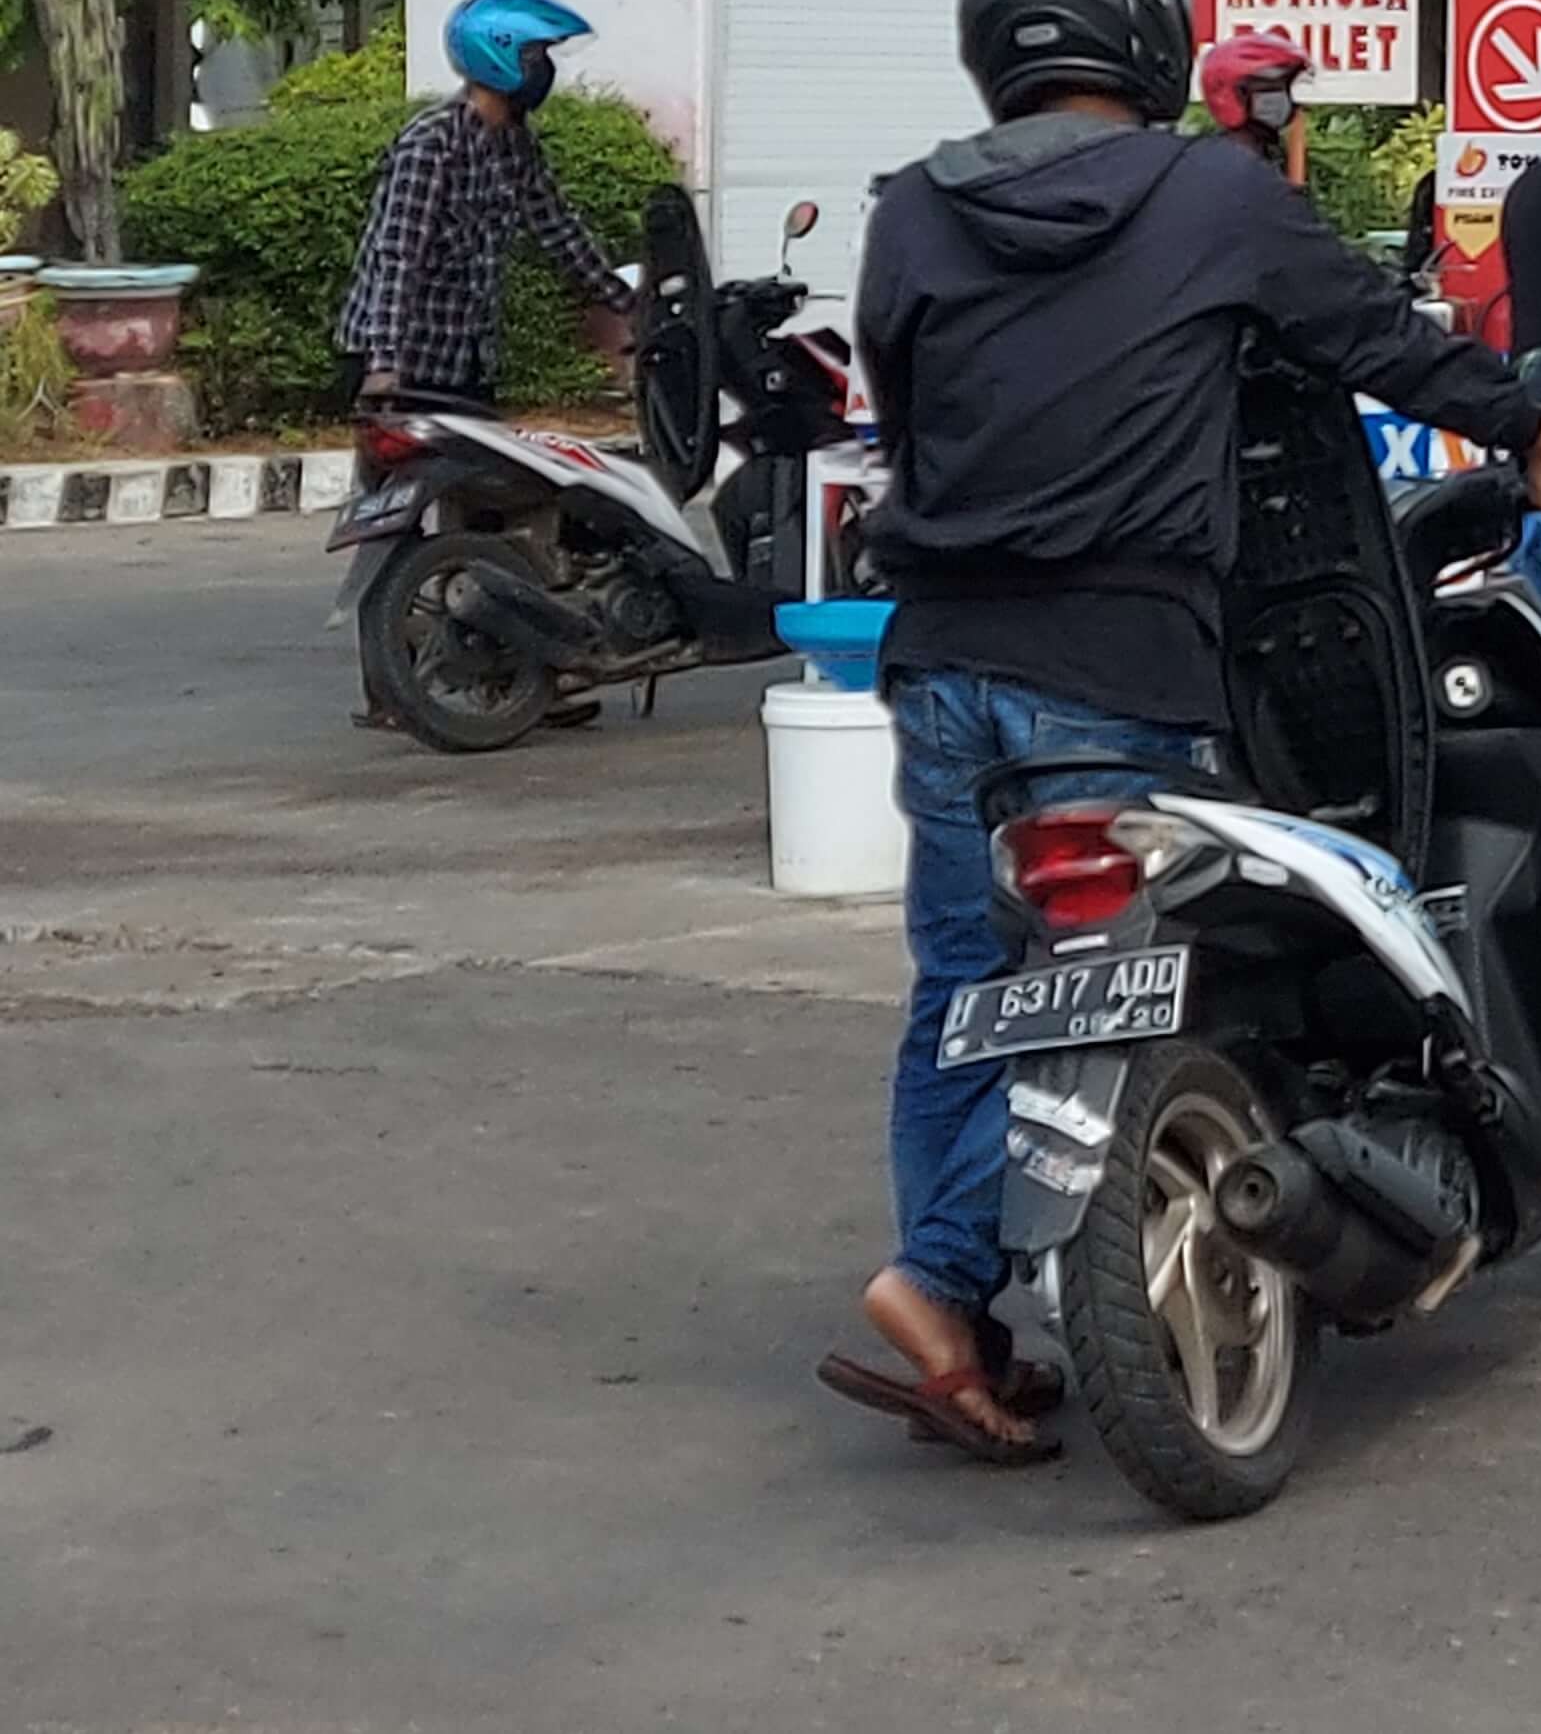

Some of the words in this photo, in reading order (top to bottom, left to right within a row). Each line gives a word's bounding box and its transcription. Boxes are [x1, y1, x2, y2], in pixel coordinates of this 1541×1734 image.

[1233, 24, 1398, 71] ILET
[1000, 968, 1091, 1018] 6317
[1105, 956, 1178, 1003] ADD
